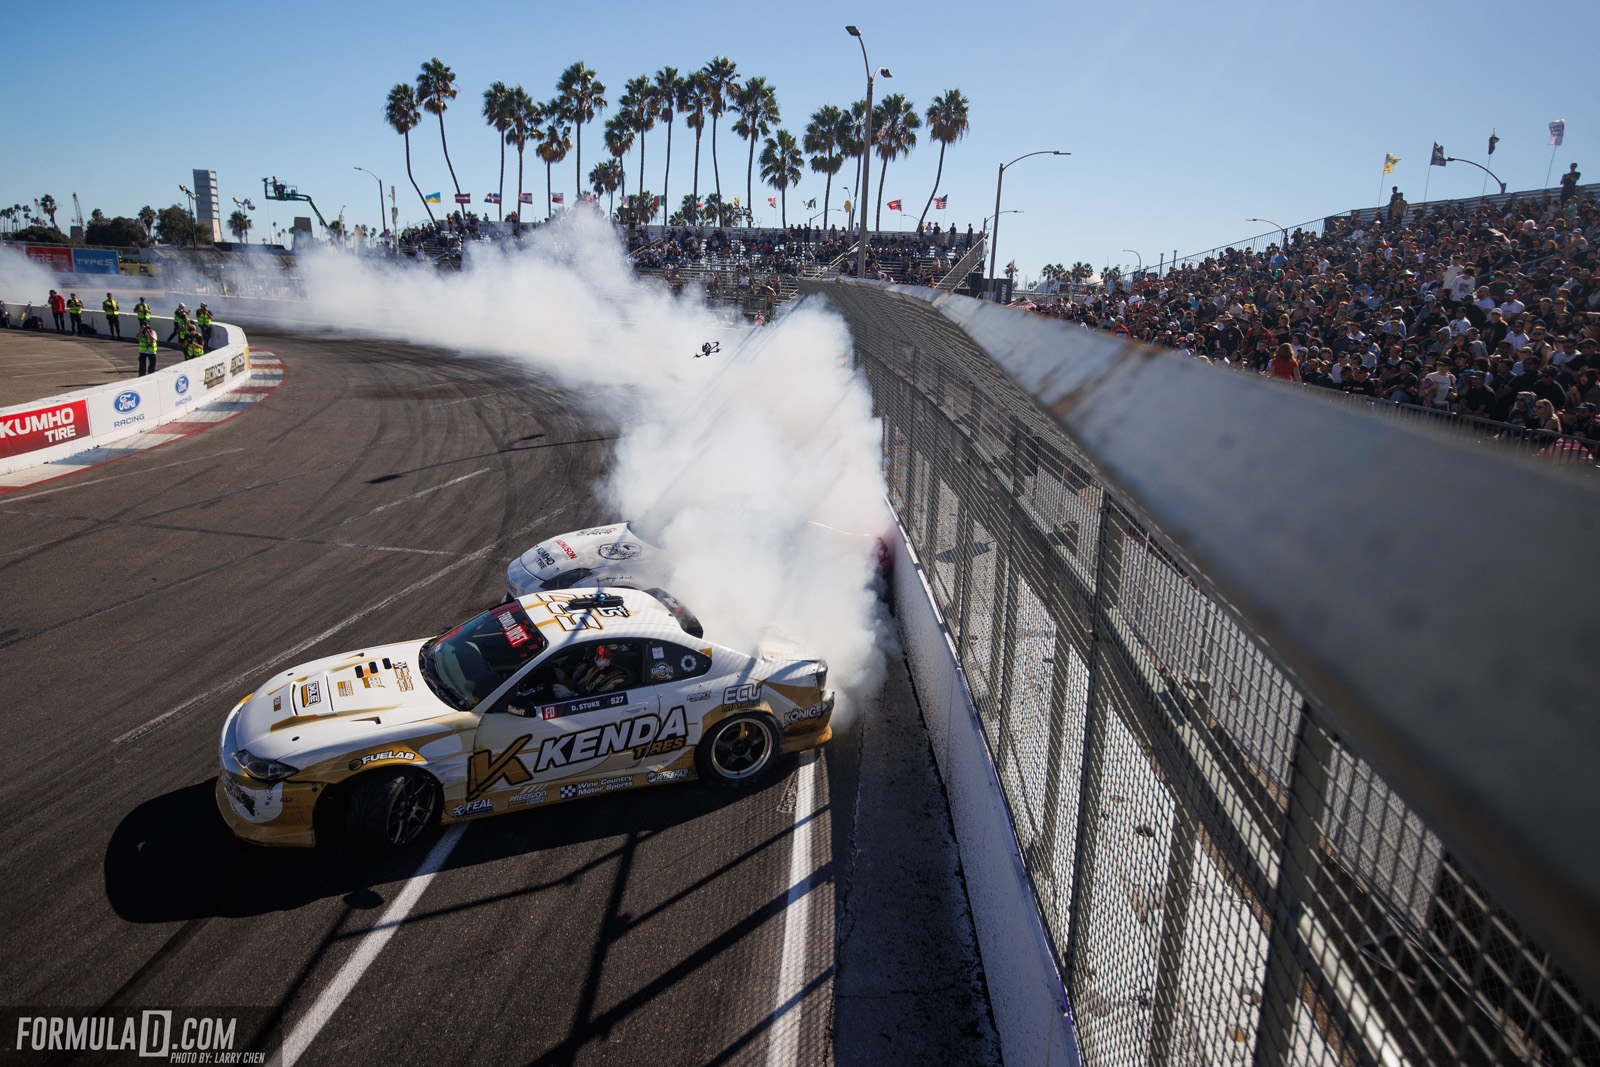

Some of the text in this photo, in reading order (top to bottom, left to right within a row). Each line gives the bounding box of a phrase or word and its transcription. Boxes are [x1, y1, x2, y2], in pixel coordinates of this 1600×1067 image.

[117, 392, 138, 411] Ford
[175, 395, 192, 407] RACING
[0, 407, 74, 438] KUMHO
[114, 413, 145, 428] RACING
[44, 425, 76, 442] TIRE
[535, 558, 547, 570] TIRE
[537, 547, 555, 566] KUMHO
[505, 625, 528, 646] DRIFT
[724, 684, 761, 705] ECU
[579, 701, 600, 710] STUKE
[784, 709, 817, 723] KÖNIG
[537, 708, 686, 770] KENDA
[634, 737, 685, 758] TIRES
[361, 751, 415, 765] FUELAB
[577, 775, 633, 789] Wine Country
[578, 781, 633, 796] Motor Sports
[509, 790, 546, 802] PRECISION
[467, 799, 493, 810] FEAL
